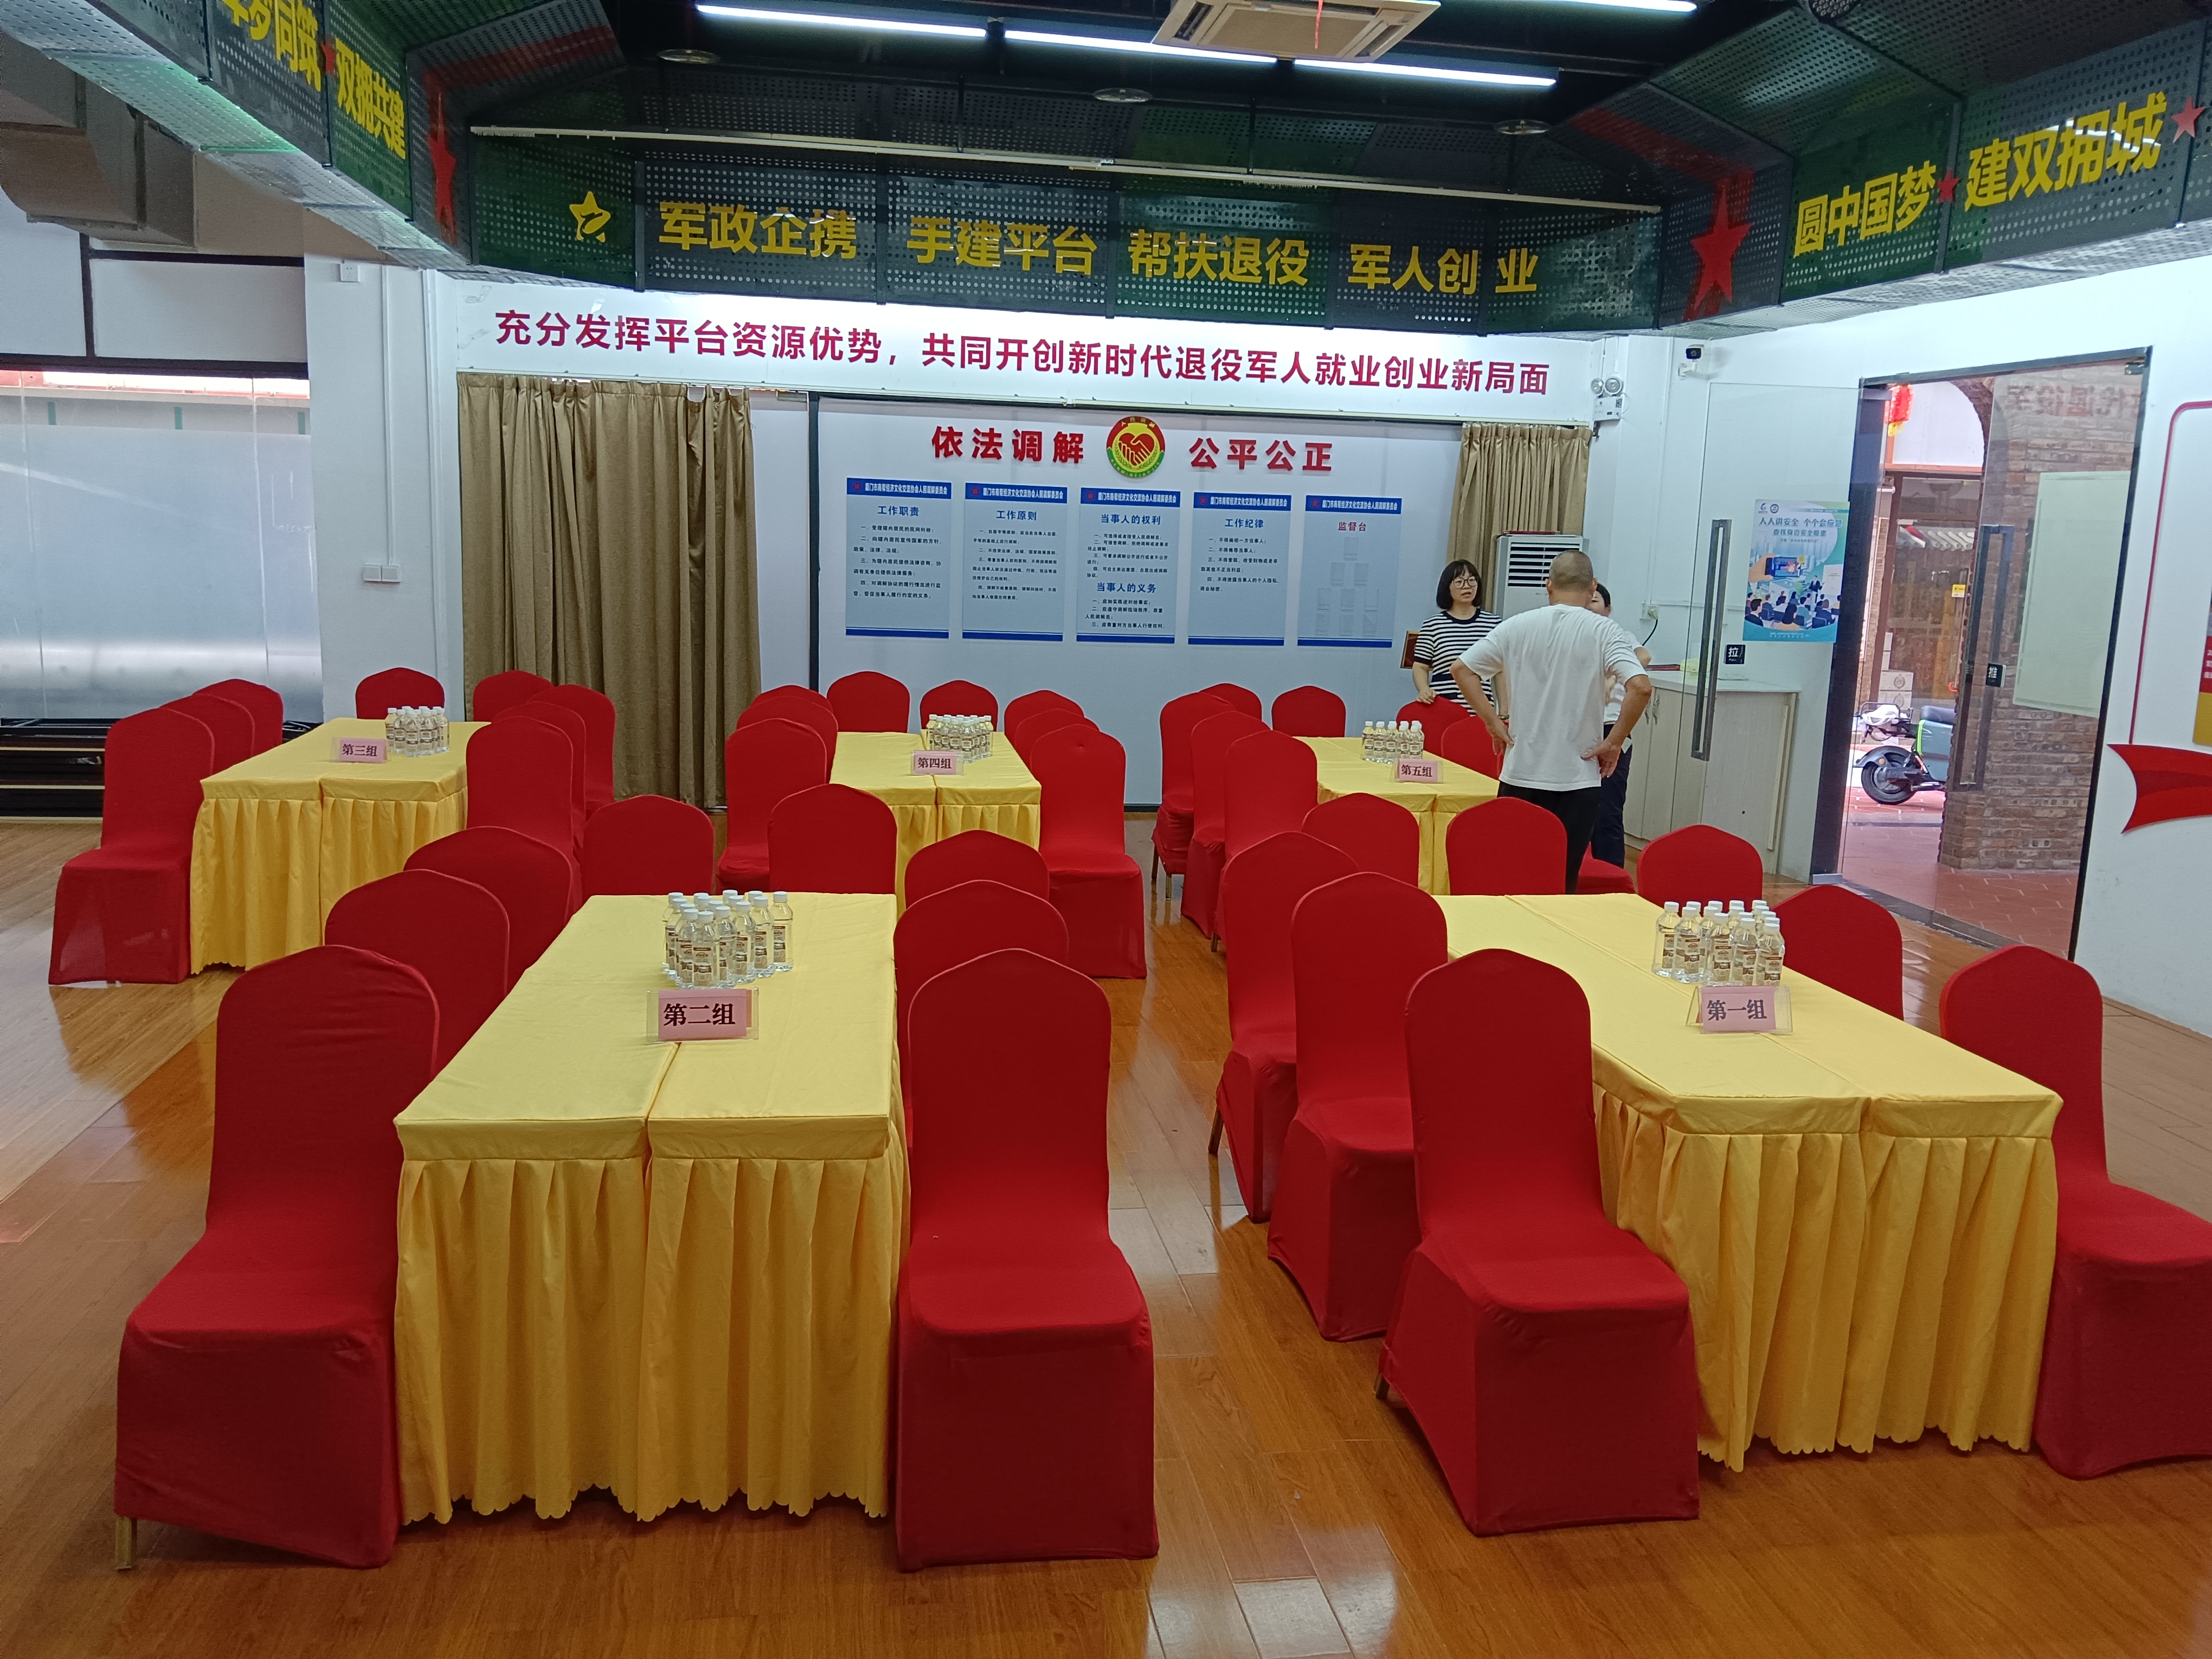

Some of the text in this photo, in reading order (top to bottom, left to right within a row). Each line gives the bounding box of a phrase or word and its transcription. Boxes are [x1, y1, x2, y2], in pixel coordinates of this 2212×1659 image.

[336, 37, 406, 159] 双拥共建
[1793, 91, 2167, 258] 圆中国梦 建双拥城
[659, 201, 857, 260] 军政企携
[908, 217, 1097, 276] 手建平台
[1128, 229, 1309, 286] 帮扶退役
[931, 426, 1084, 464] 依法调解
[1188, 438, 1333, 472] 公平公正
[877, 506, 919, 516] 工作职责
[996, 510, 1037, 520] 工作原则
[1101, 513, 1161, 525] 当事人的权利
[1224, 518, 1264, 528] 工作纪律
[1759, 517, 1799, 526] 人人讲安全
[1338, 521, 1367, 531] 监督台
[1097, 582, 1156, 593] 当事人的义务
[1728, 647, 1739, 658] 拉
[1988, 666, 1998, 678] 推
[342, 744, 377, 757] 第三组
[917, 757, 952, 769] 第四组
[1401, 764, 1432, 777] 第五组
[664, 1003, 736, 1026] 第二组
[1707, 999, 1767, 1021] 第一组
